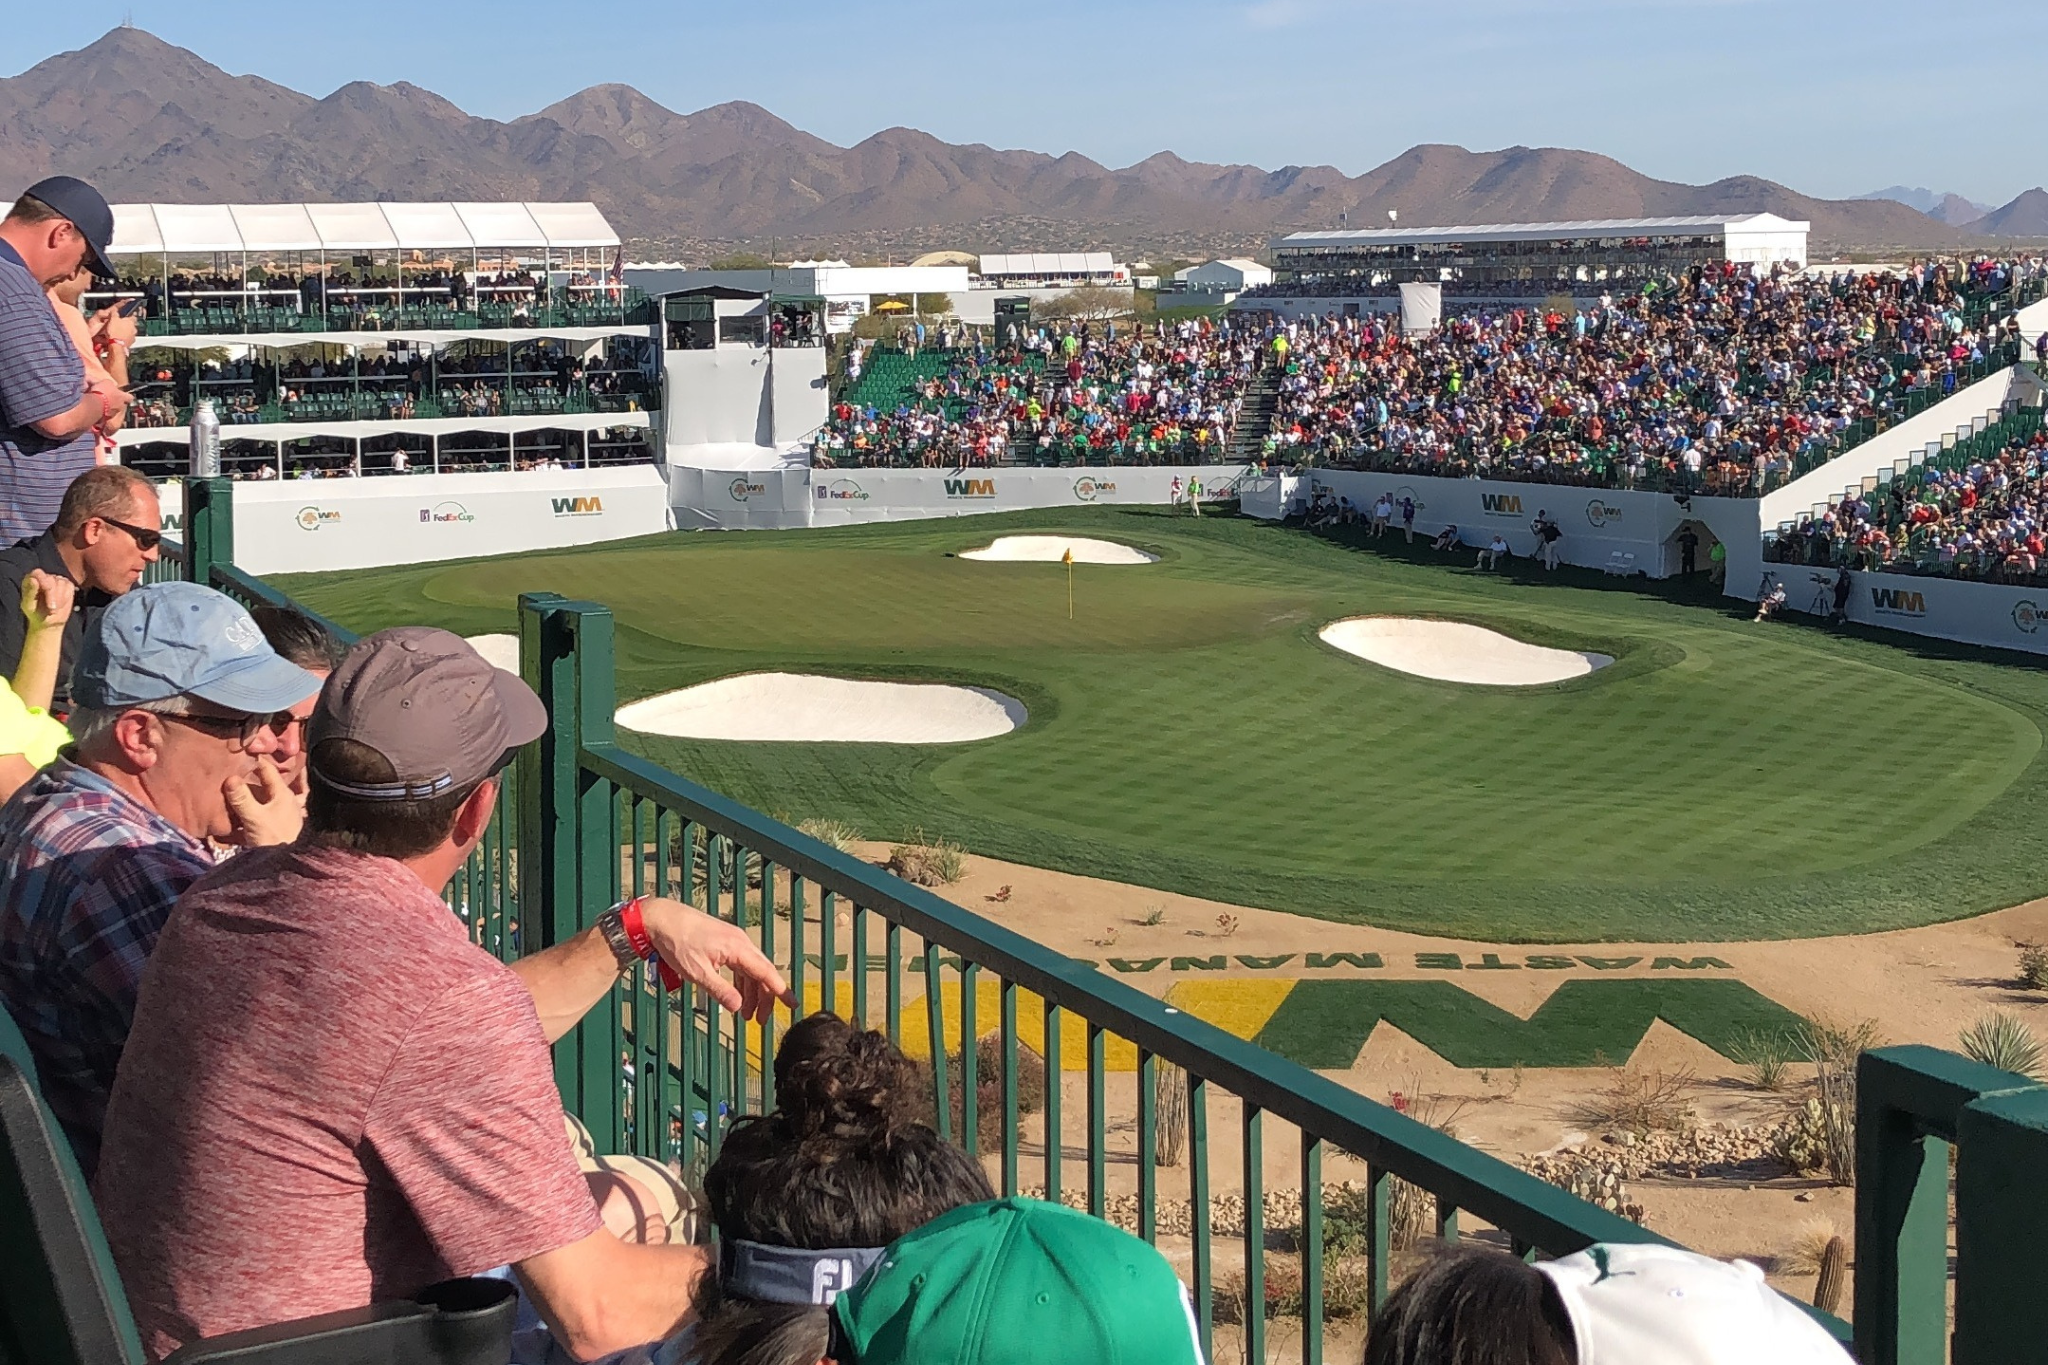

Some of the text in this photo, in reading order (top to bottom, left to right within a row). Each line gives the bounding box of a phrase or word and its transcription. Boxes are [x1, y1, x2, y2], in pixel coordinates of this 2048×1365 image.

[746, 484, 765, 494] WM
[944, 479, 996, 495] WM
[1094, 482, 1116, 490] WM
[830, 490, 870, 501] FedExCup
[550, 496, 602, 513] WM
[1481, 493, 1525, 513] WM
[318, 511, 341, 519] WM
[1603, 506, 1622, 517] WM
[433, 512, 475, 523] FedExCup
[1871, 587, 1926, 612] WM
[1414, 953, 1735, 971] WASTE
